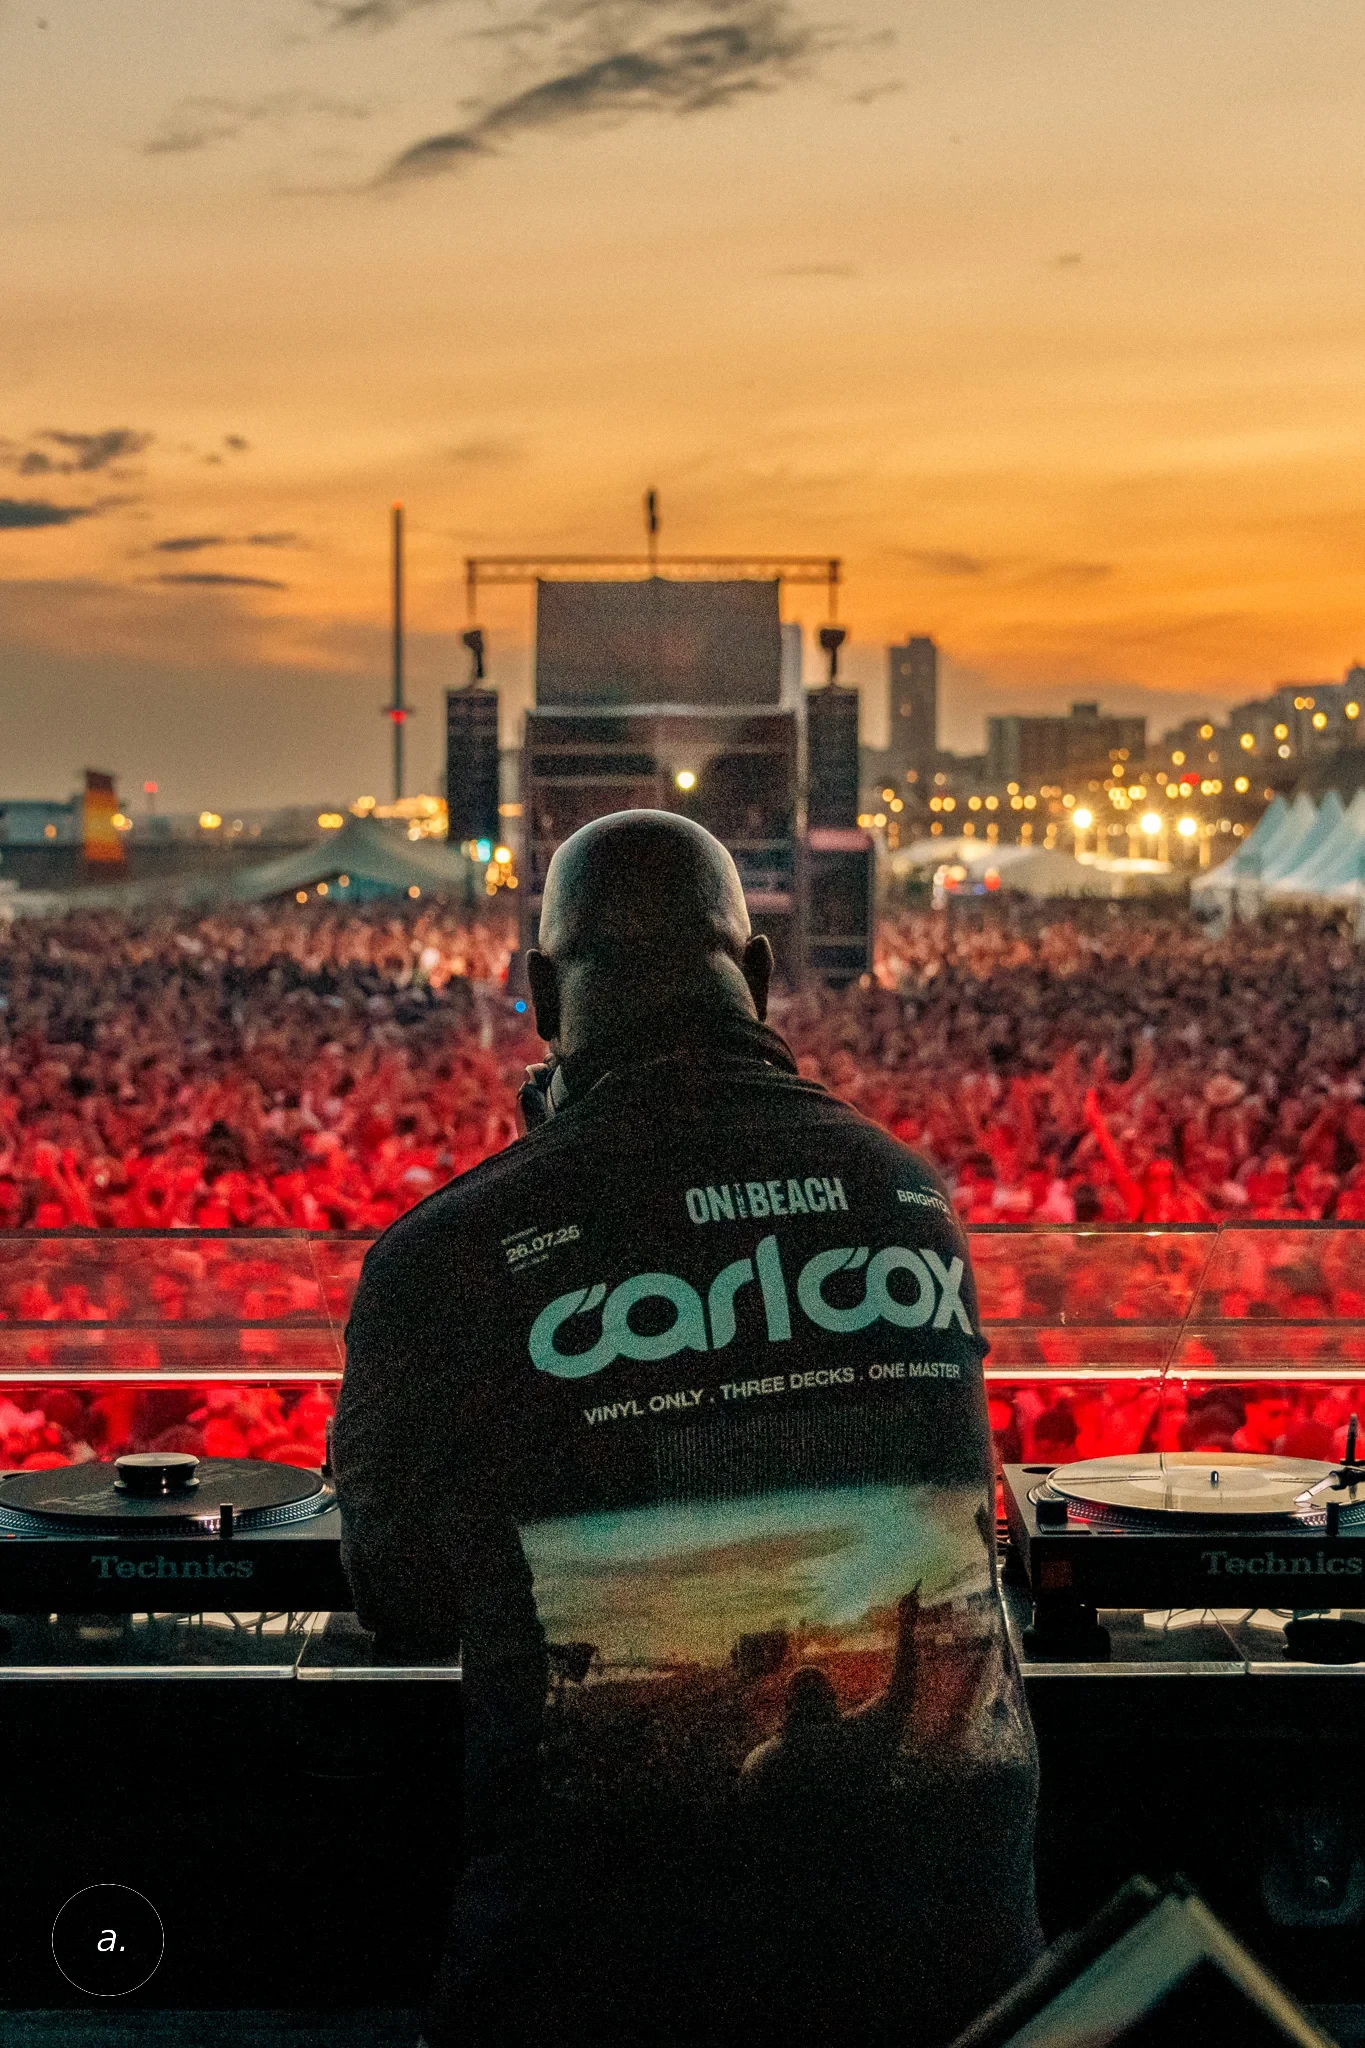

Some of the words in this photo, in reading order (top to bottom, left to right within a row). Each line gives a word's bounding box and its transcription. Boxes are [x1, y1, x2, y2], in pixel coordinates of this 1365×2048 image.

[685, 1186, 736, 1224] ON
[745, 1177, 850, 1218] BEACH
[897, 1189, 951, 1215] BRIGHTO
[506, 1224, 580, 1264] 26.07.25
[583, 1401, 644, 1425] VINYL
[650, 1388, 704, 1411] ONLY
[720, 1376, 785, 1400] THREE
[790, 1367, 855, 1389] DECKS
[869, 1363, 906, 1379] ONE
[909, 1362, 961, 1379] MASTER
[91, 1554, 254, 1579] Technics
[1201, 1551, 1363, 1575] Technics
